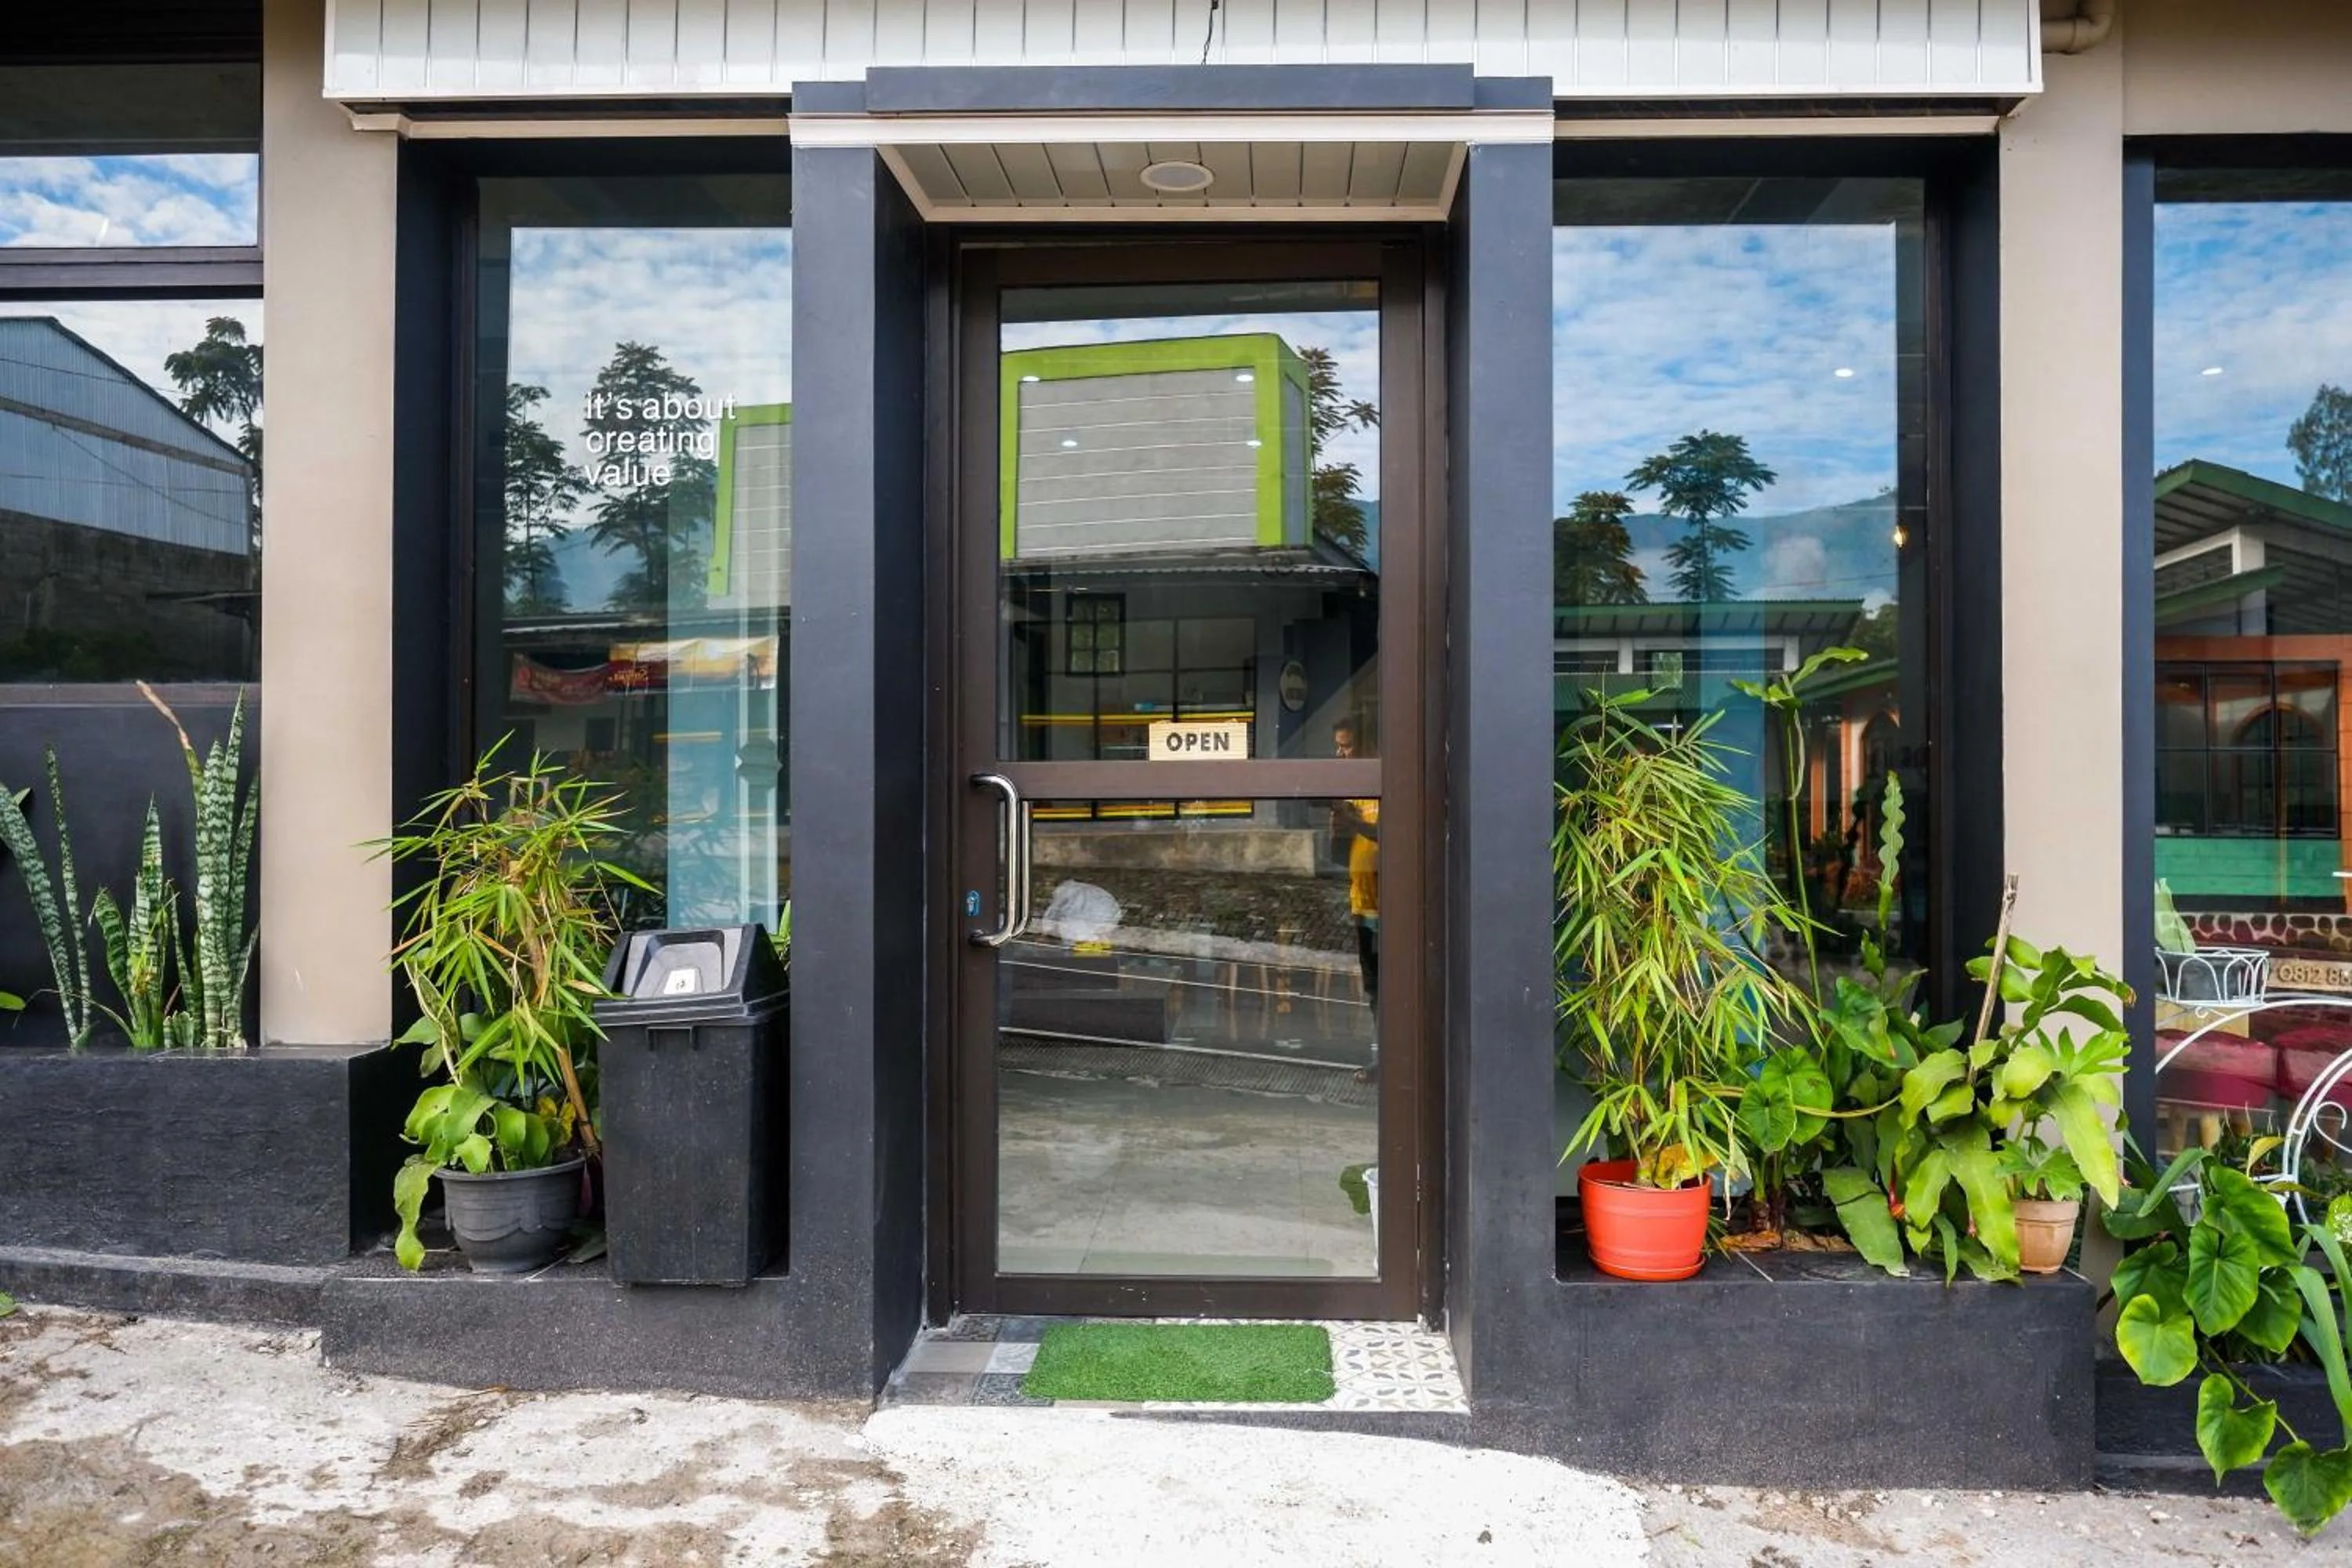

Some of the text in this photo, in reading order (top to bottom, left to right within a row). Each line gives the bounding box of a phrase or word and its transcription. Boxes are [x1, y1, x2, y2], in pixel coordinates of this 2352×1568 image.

[641, 391, 736, 420] about
[586, 423, 714, 460] creating
[585, 456, 671, 486] value
[1167, 732, 1229, 751] OPEN
